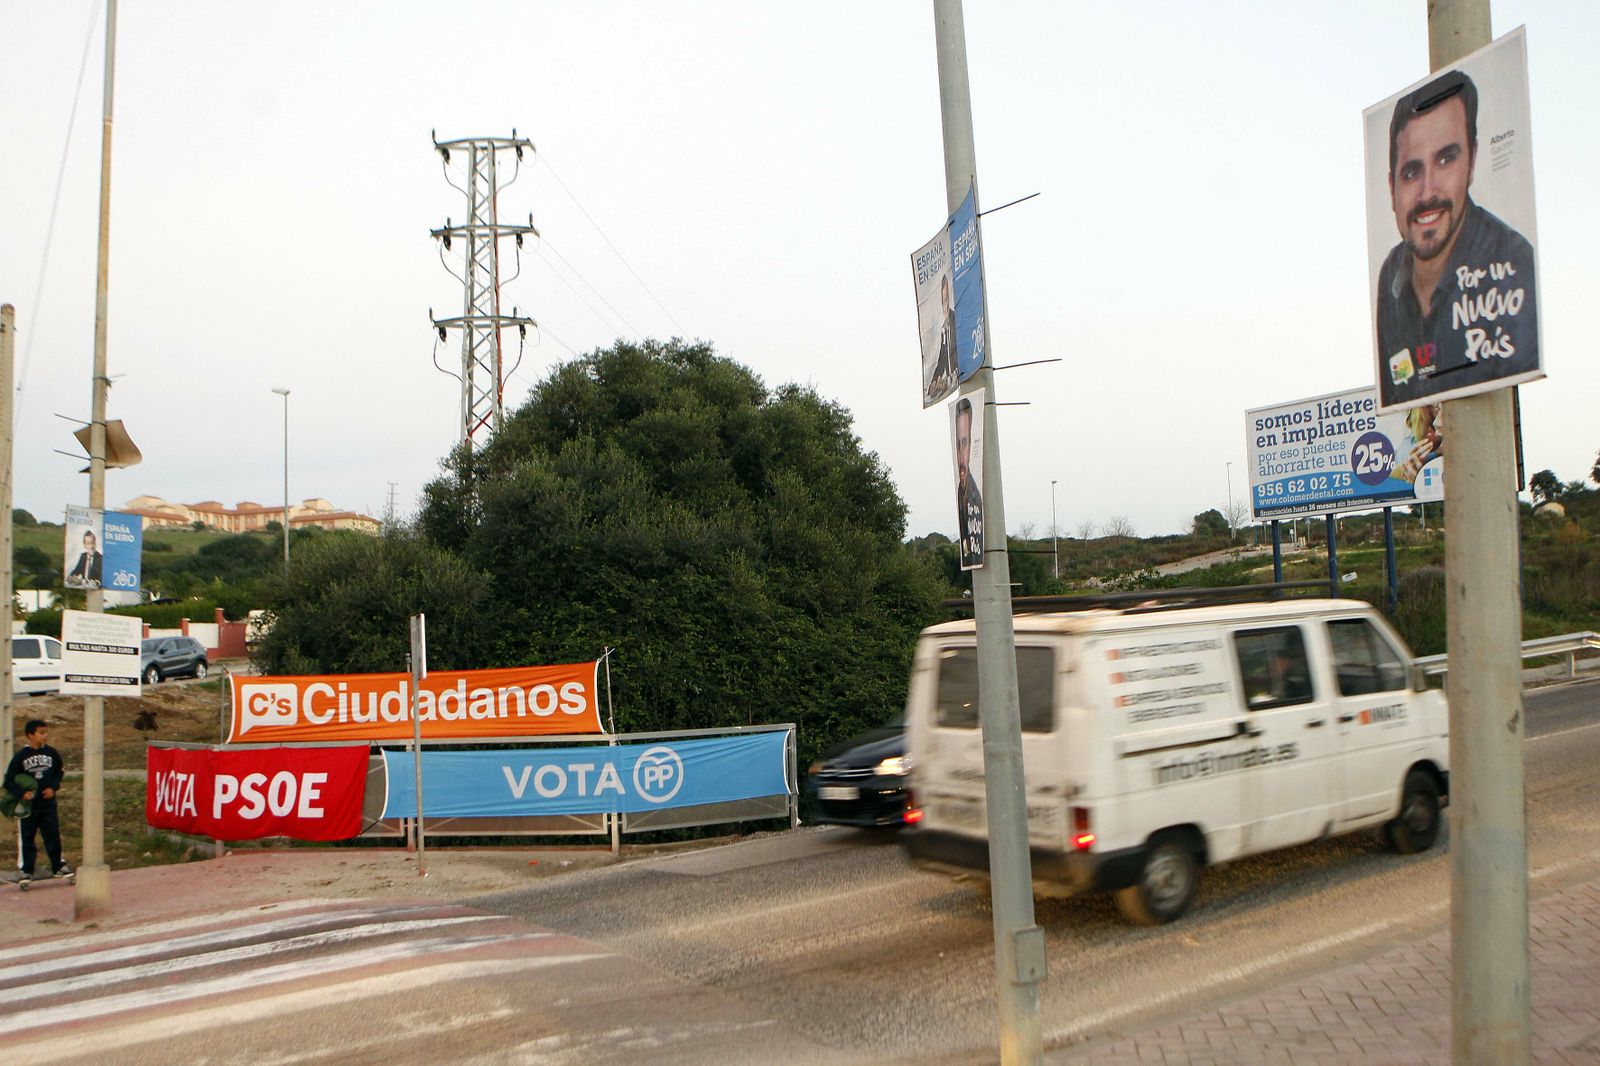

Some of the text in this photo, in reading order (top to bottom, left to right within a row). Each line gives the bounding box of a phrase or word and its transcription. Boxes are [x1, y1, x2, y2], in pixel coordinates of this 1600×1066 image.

[1490, 129, 1515, 146] Alberto
[916, 241, 944, 271] ESPAÑA
[918, 268, 929, 285] EN
[1456, 262, 1516, 291] Por un
[1452, 287, 1524, 330] Nuevo
[1465, 326, 1515, 362] País
[1256, 398, 1376, 431] somos lídere
[1256, 416, 1376, 448] en implantes
[1258, 440, 1346, 466] por eso puedes
[1259, 454, 1348, 477] ahorrarte un
[1258, 473, 1351, 497] 956 62 02 75
[1259, 487, 1354, 506] www.colomerdental.com
[1293, 504, 1308, 512] hasta
[1317, 502, 1337, 510] meses
[303, 679, 587, 725] Ciudadanos
[23, 754, 52, 770] OXFORD
[155, 770, 328, 820] VOTA PSOE
[502, 762, 674, 799] VOTA PP
